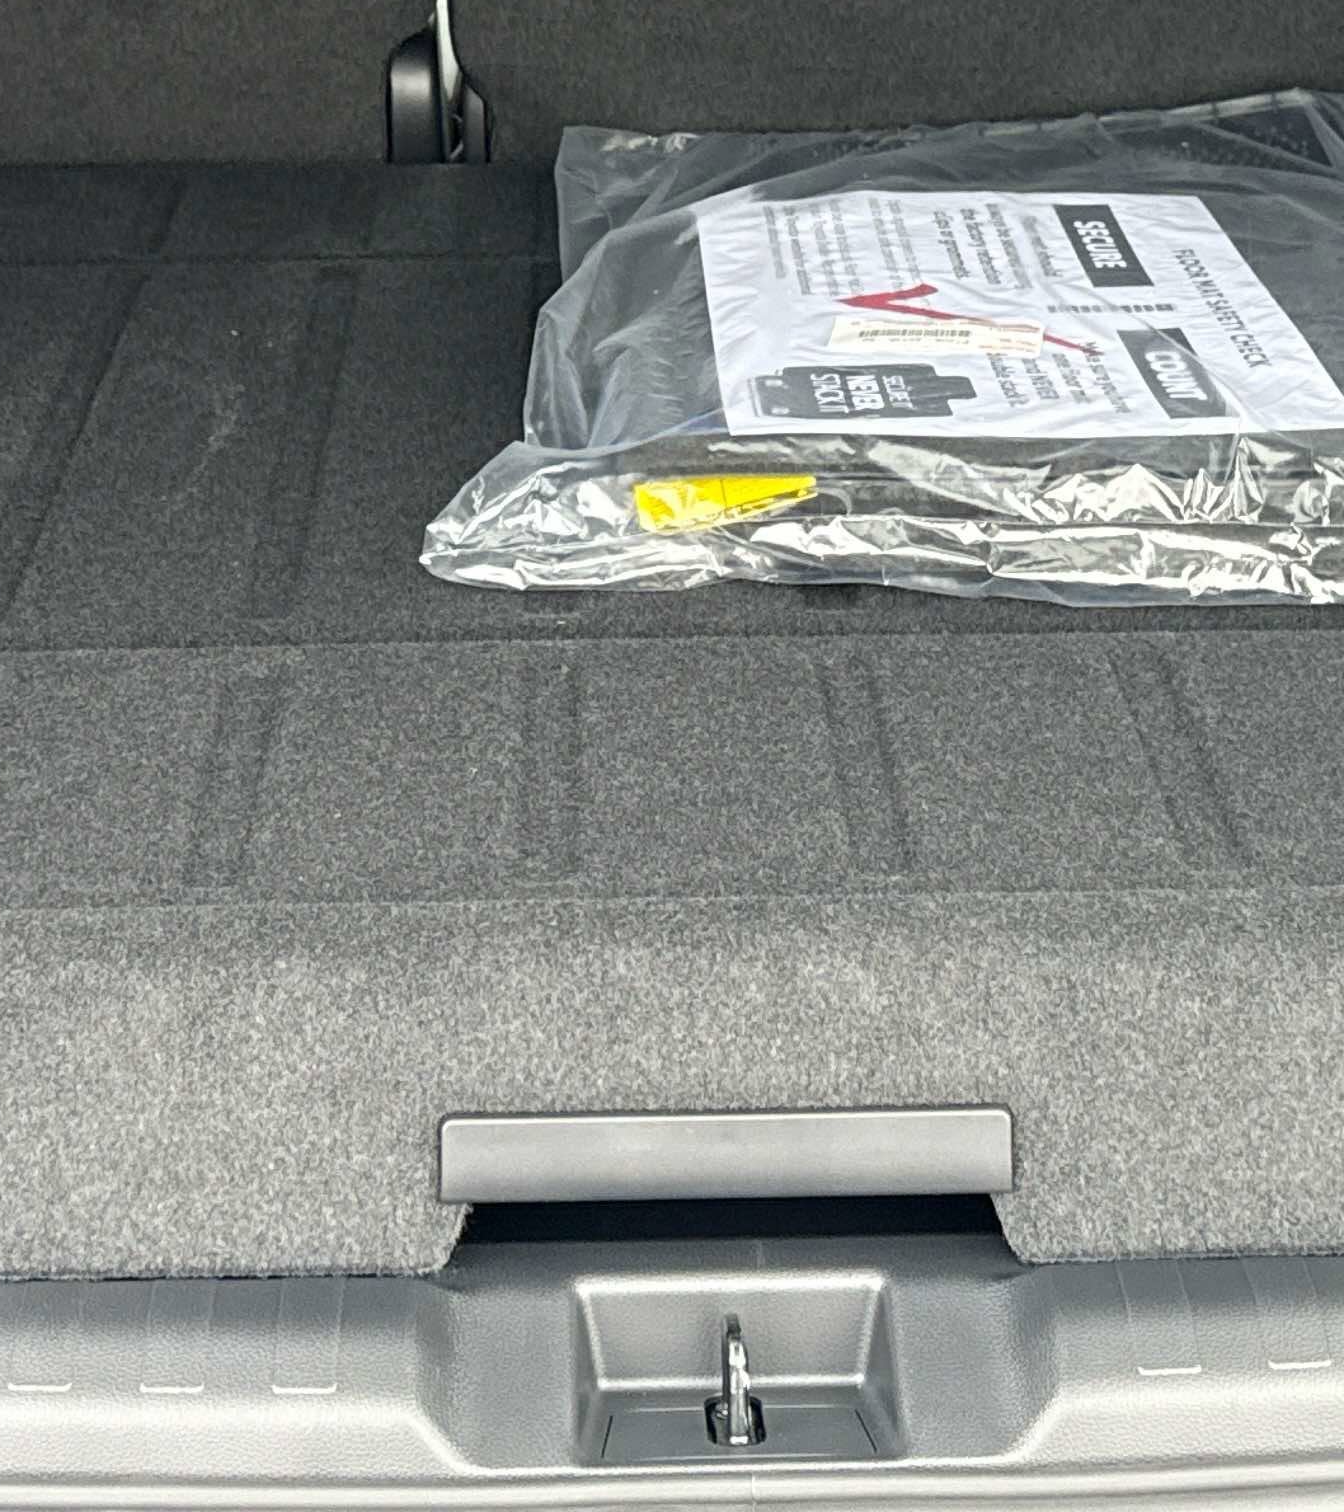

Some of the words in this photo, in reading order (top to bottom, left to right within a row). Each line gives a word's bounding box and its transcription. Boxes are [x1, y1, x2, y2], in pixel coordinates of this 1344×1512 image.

[1072, 219, 1129, 268] SECURE
[1170, 248, 1211, 278] FLOOR
[1192, 279, 1225, 299] MAT
[1205, 299, 1249, 332] SAFETY
[1227, 334, 1274, 367] CHECK
[809, 371, 844, 401] STACK
[844, 373, 884, 410] NEVER
[1143, 351, 1208, 400] COUNT
